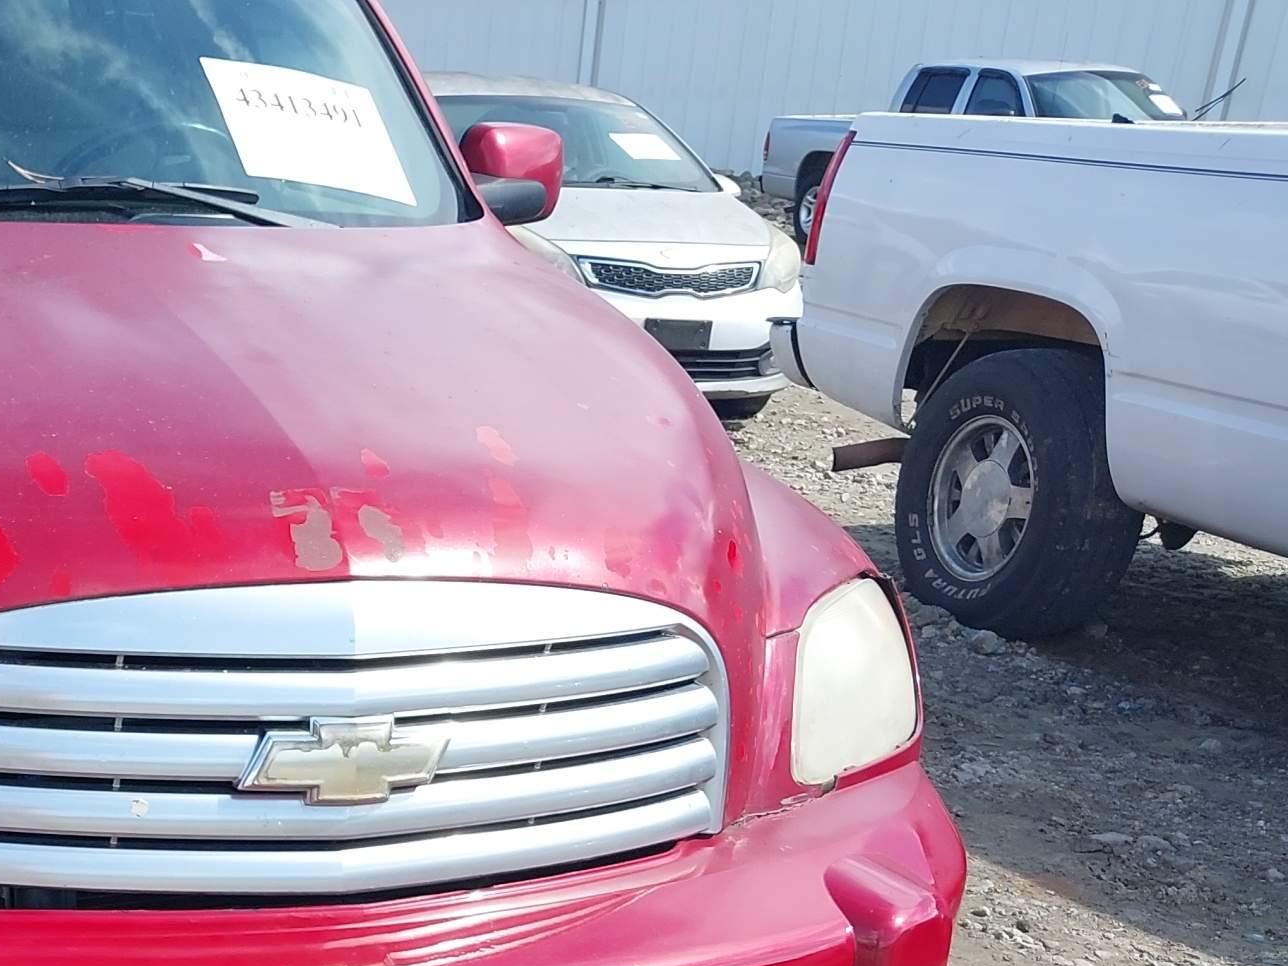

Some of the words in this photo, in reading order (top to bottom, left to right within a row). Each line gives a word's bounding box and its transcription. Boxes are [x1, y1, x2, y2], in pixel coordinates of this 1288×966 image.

[235, 87, 363, 128] 43413491
[949, 395, 1005, 420] SUPER
[908, 513, 927, 561] GLS
